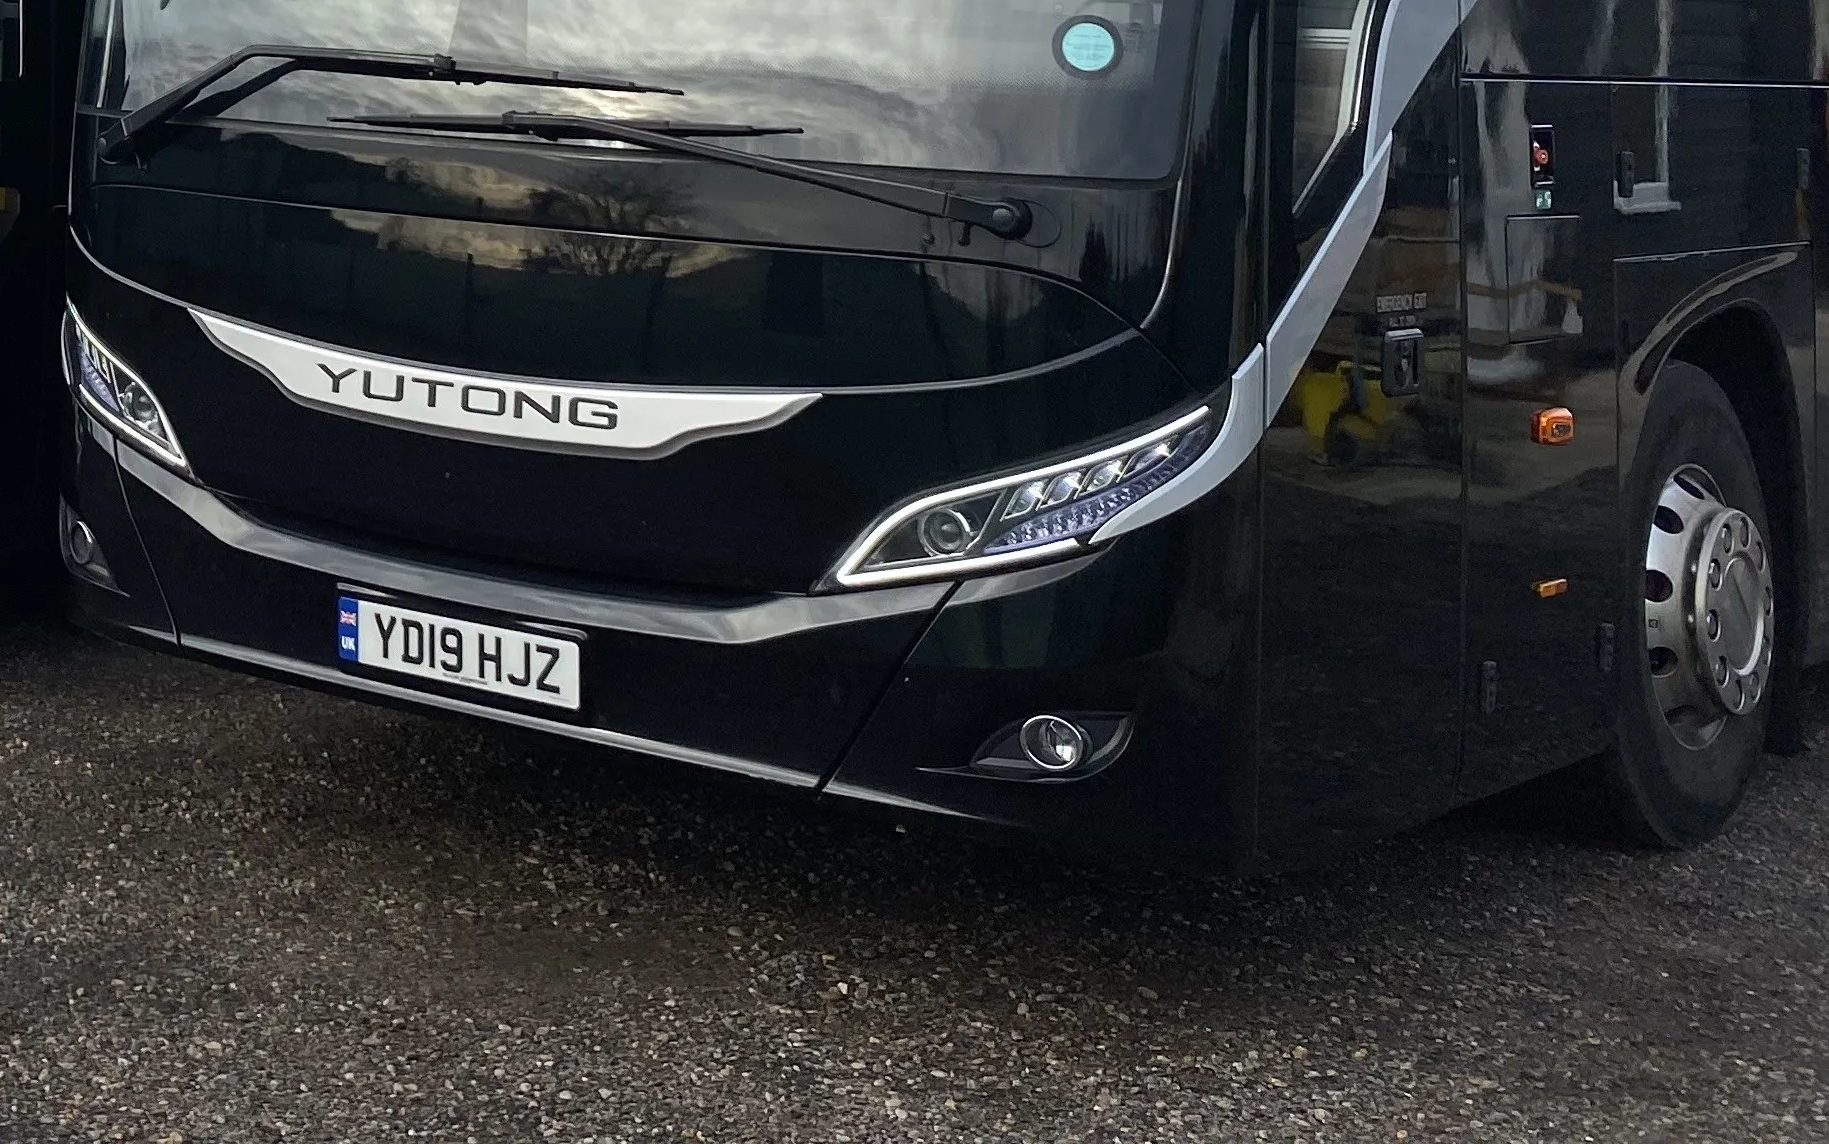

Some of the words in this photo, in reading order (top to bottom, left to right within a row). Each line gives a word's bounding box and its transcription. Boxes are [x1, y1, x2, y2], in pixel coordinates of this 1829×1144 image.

[316, 362, 619, 430] YUTONG
[340, 636, 357, 652] UK
[374, 612, 463, 674] YD19
[478, 632, 561, 695] HJZ
